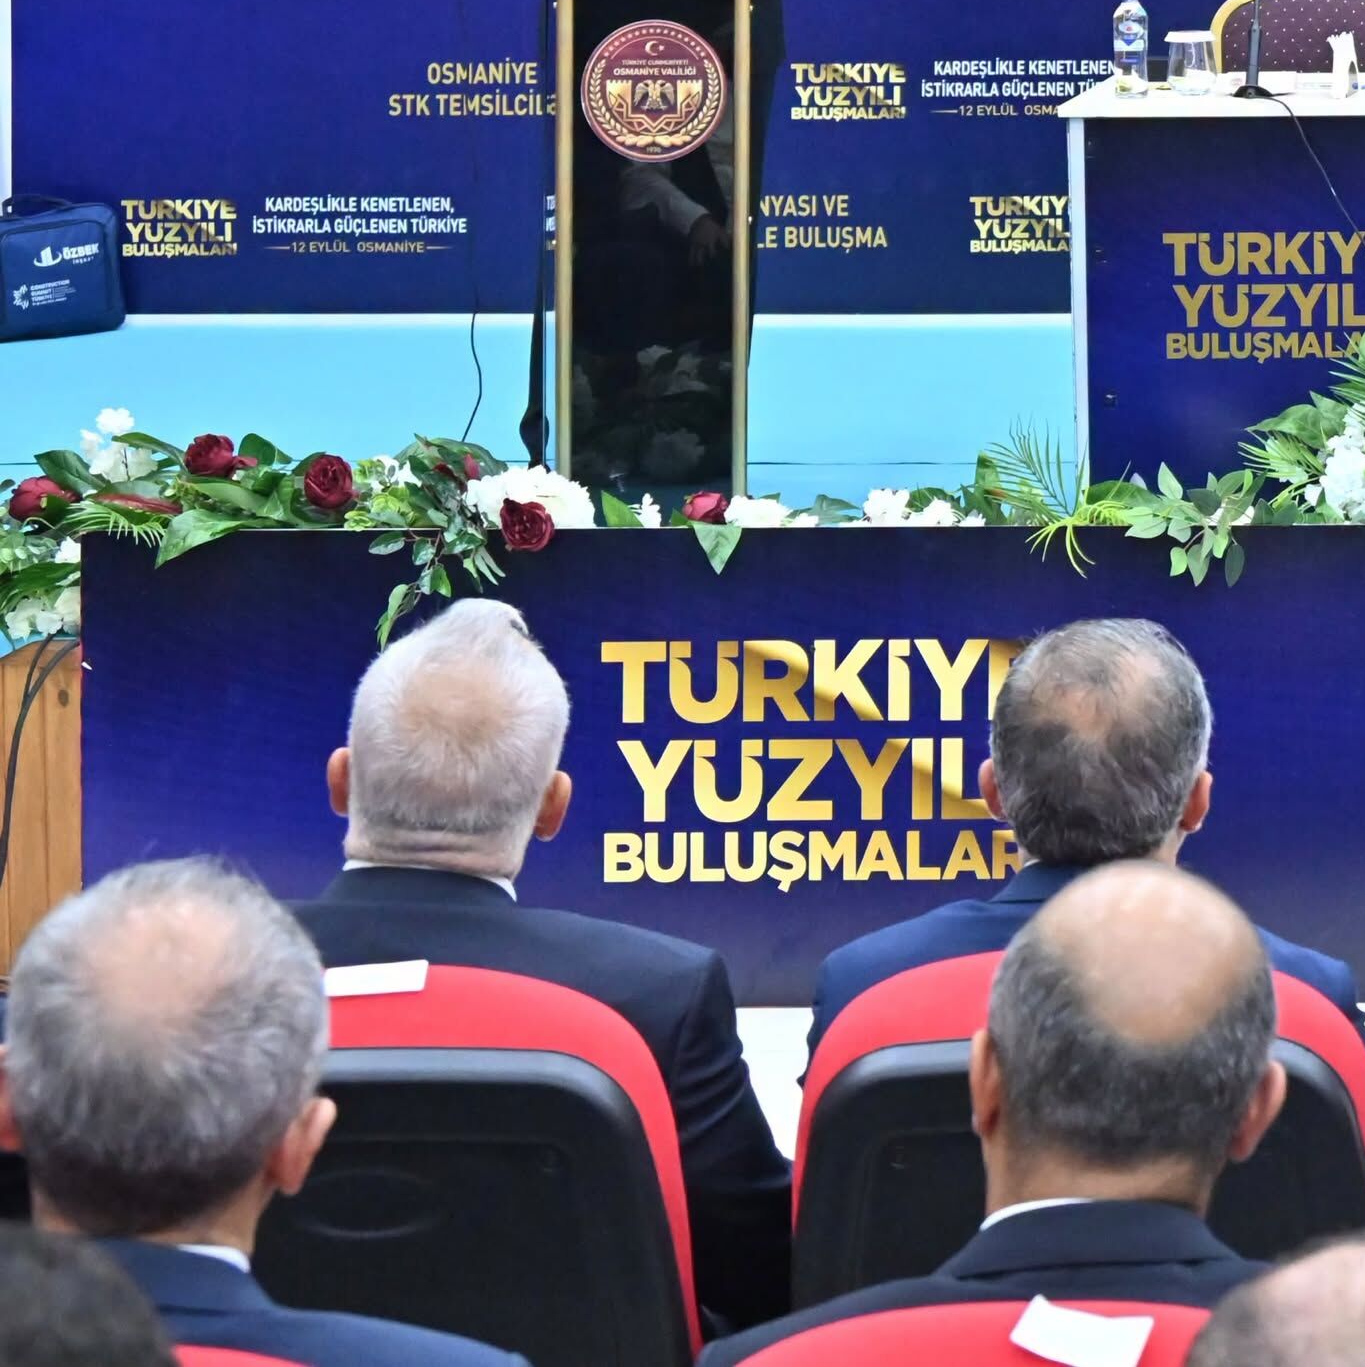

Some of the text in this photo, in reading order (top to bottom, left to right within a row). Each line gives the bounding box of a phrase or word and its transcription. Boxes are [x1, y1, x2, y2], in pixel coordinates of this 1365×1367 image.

[614, 67, 659, 76] OSMANİYE
[265, 193, 455, 220] KARDEŞLİKLE KENETLENEN,
[252, 214, 468, 237] İSTİKRARLA GÜÇLENEN TÜRKİYE
[62, 243, 99, 260] ÖZBEK
[616, 737, 990, 825] YÜZYIL
[602, 829, 1022, 894] BULUŞMALAR
